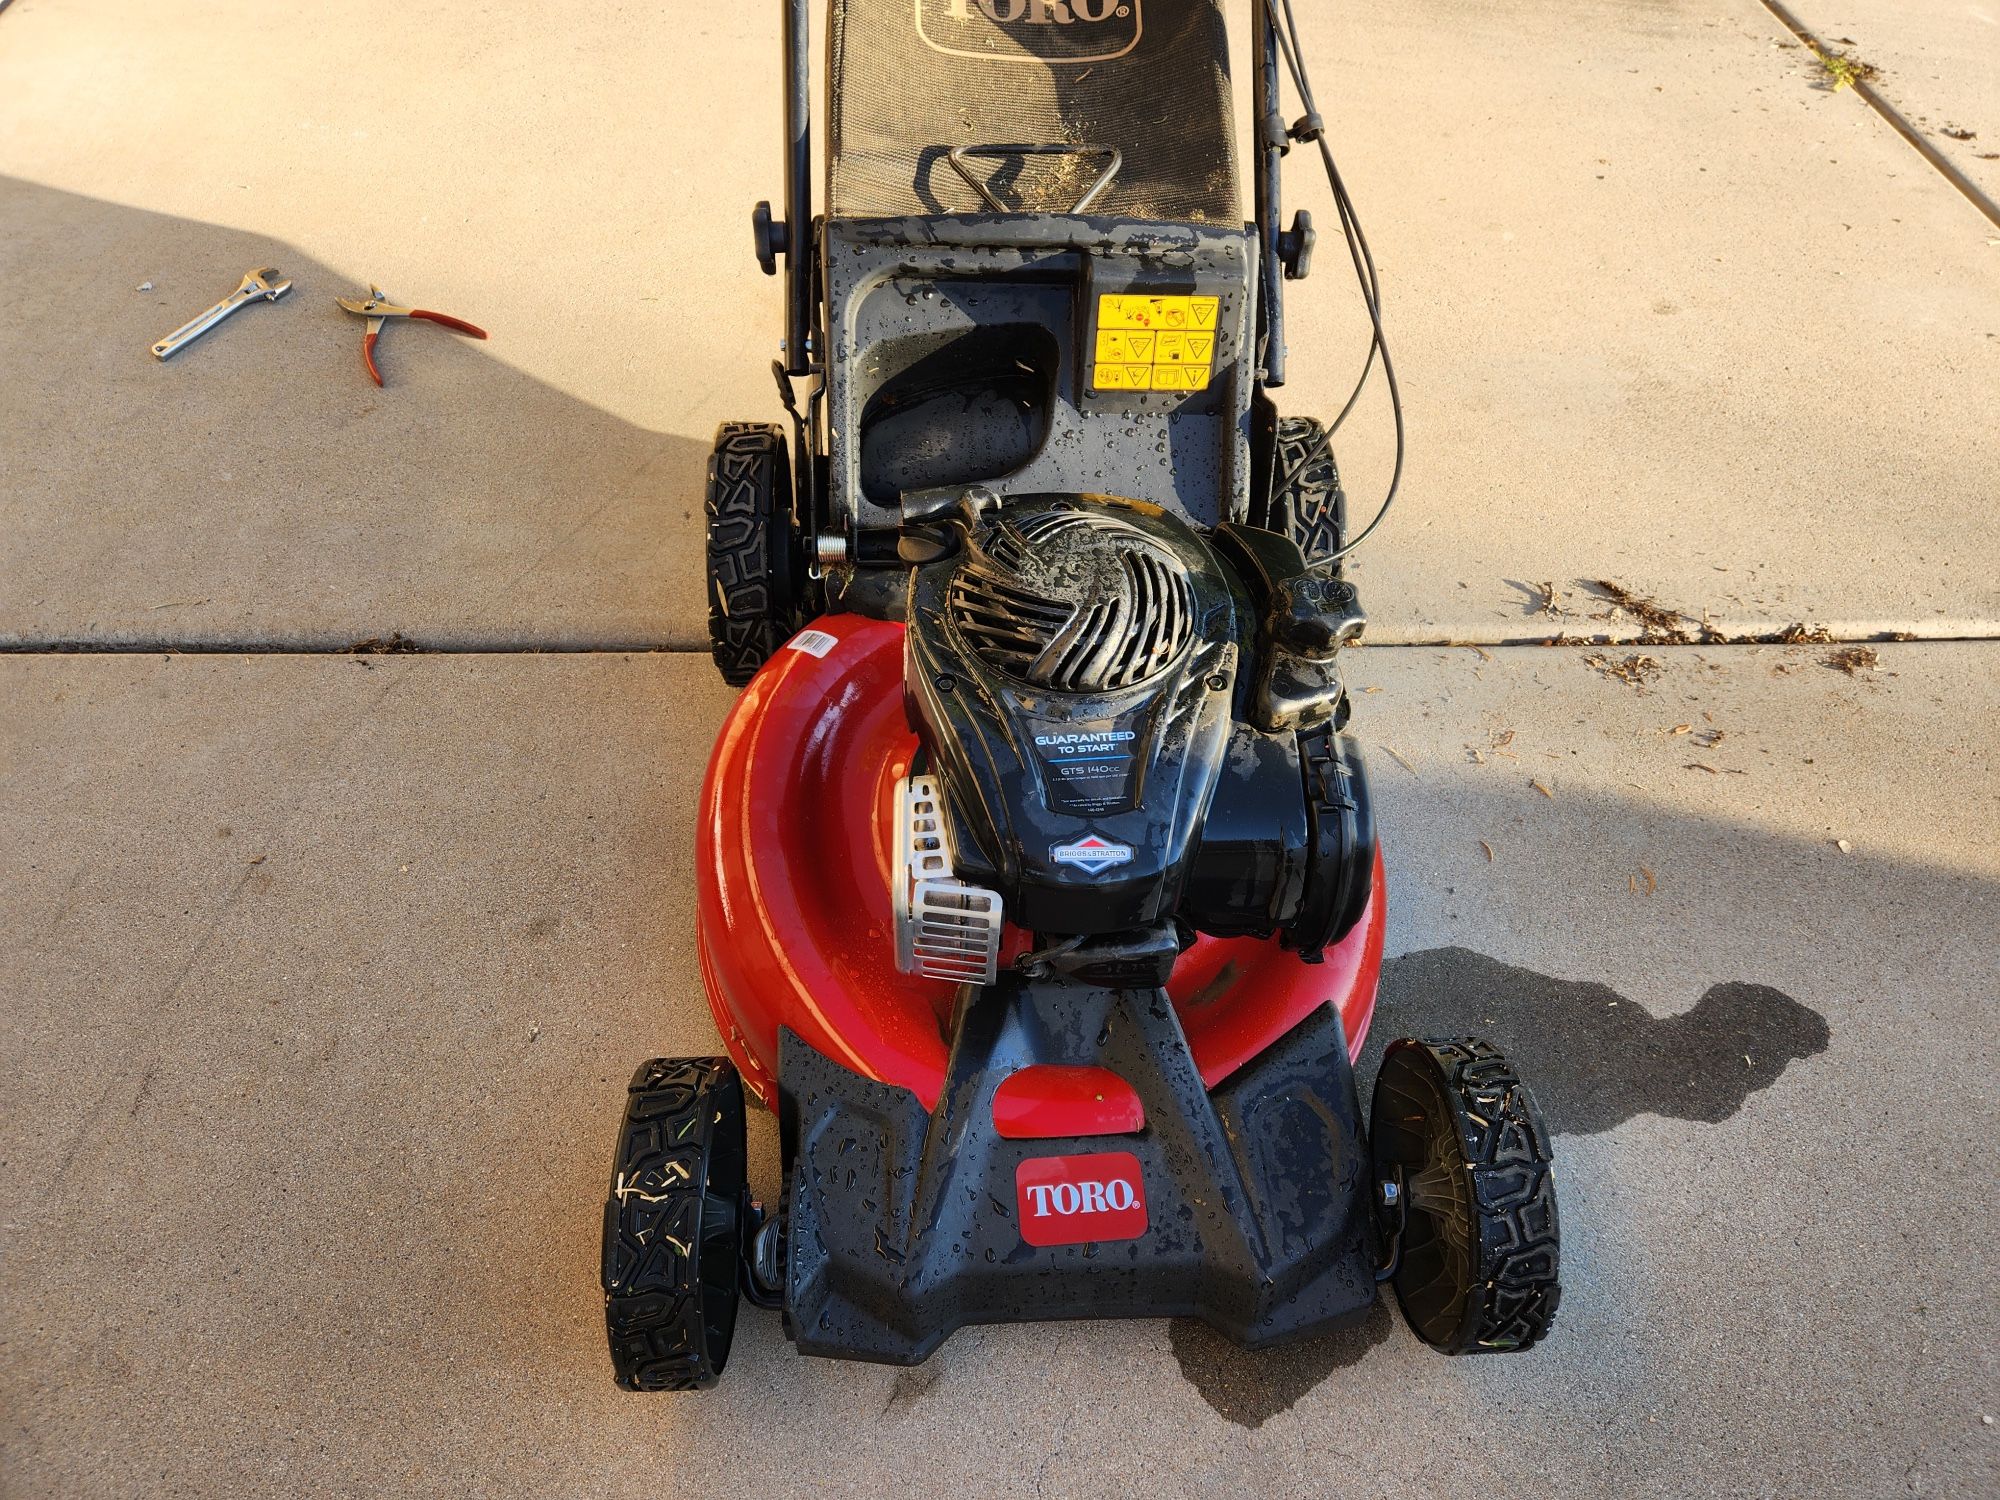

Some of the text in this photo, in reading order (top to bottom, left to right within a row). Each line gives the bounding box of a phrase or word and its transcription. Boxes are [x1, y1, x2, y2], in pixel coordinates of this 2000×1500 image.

[1035, 732, 1135, 745] GUARANTEED
[1058, 745, 1075, 754] TO
[1062, 766, 1084, 775] GTS
